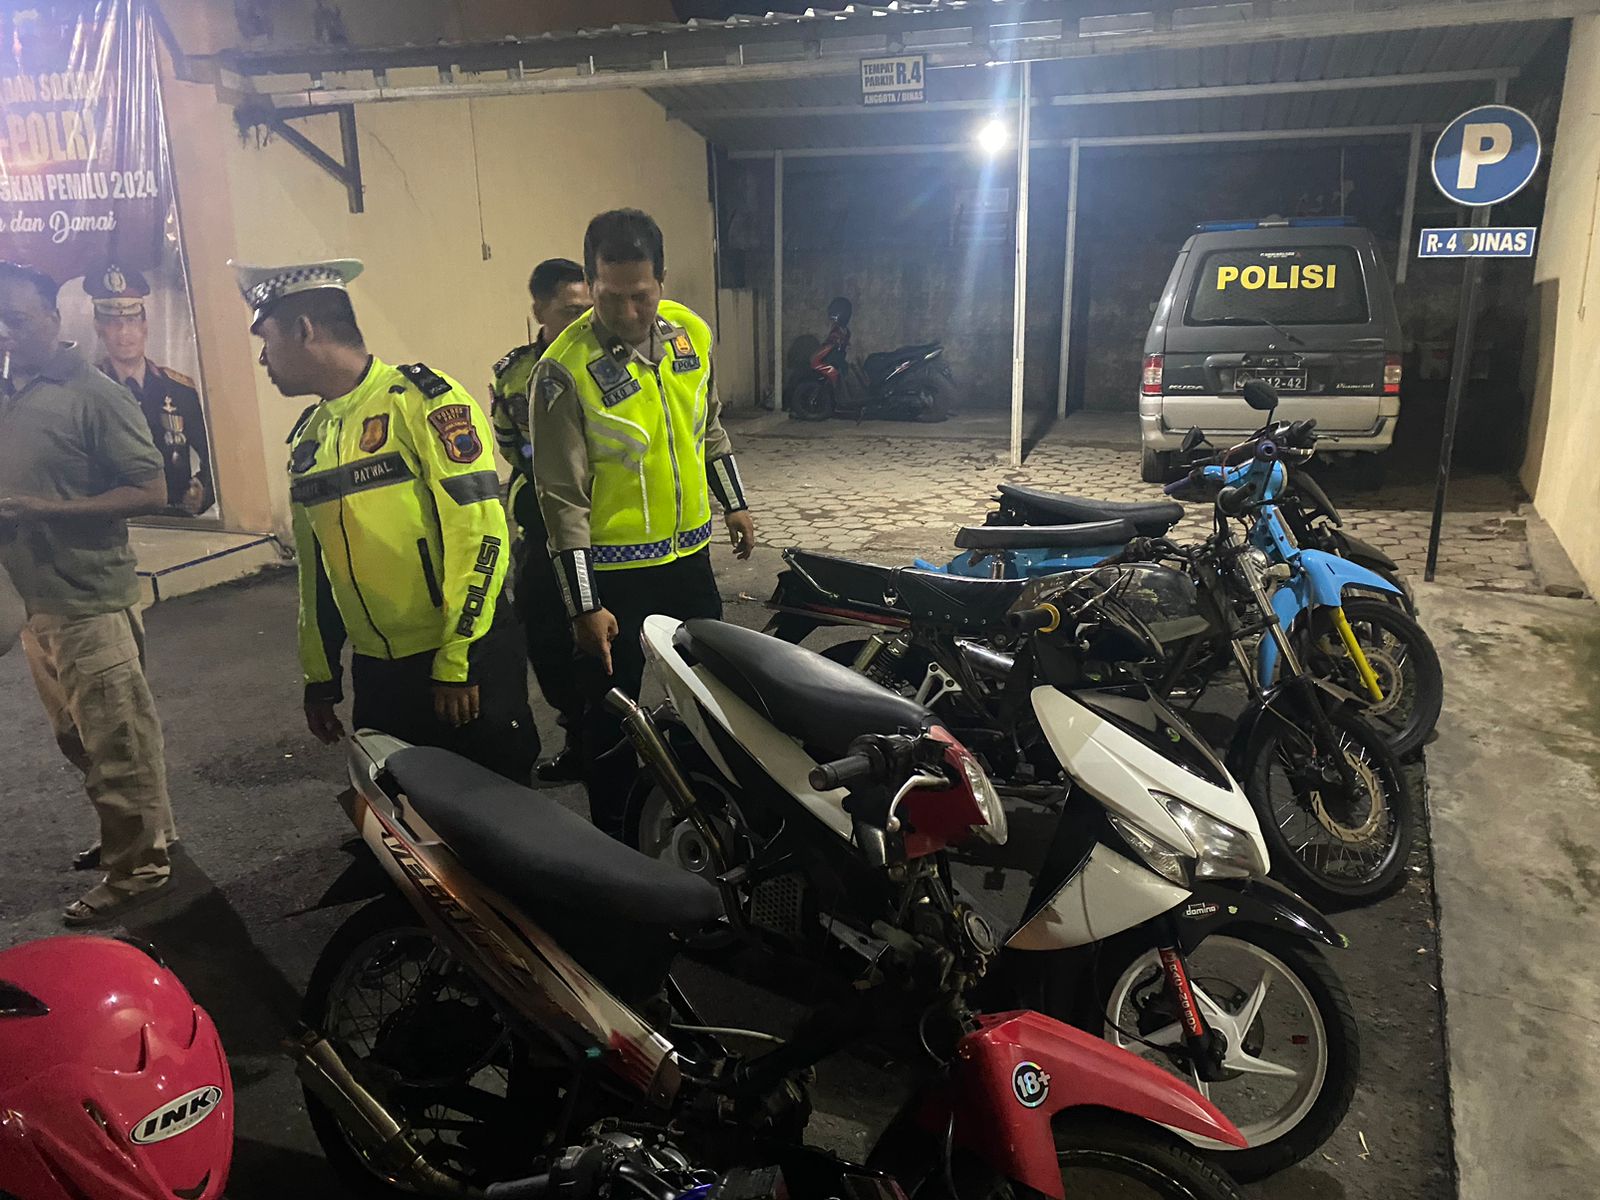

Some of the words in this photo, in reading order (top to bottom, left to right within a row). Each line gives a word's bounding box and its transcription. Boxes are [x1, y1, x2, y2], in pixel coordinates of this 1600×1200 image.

[863, 63, 895, 75] TEMPAT
[864, 75, 895, 87] PARKIR
[896, 61, 921, 84] R.4
[1456, 122, 1513, 189] P
[46, 171, 108, 200] PEMILU
[111, 170, 158, 199] 2024
[10, 210, 45, 232] dan
[49, 211, 116, 243] Damai
[1216, 264, 1337, 290] POLISI
[353, 461, 393, 484] PATWAL
[456, 535, 501, 638] POLISI
[1186, 902, 1216, 916] domino
[1169, 964, 1190, 1009] RACING
[1017, 1071, 1051, 1098] 18+
[143, 1089, 211, 1138] INK
